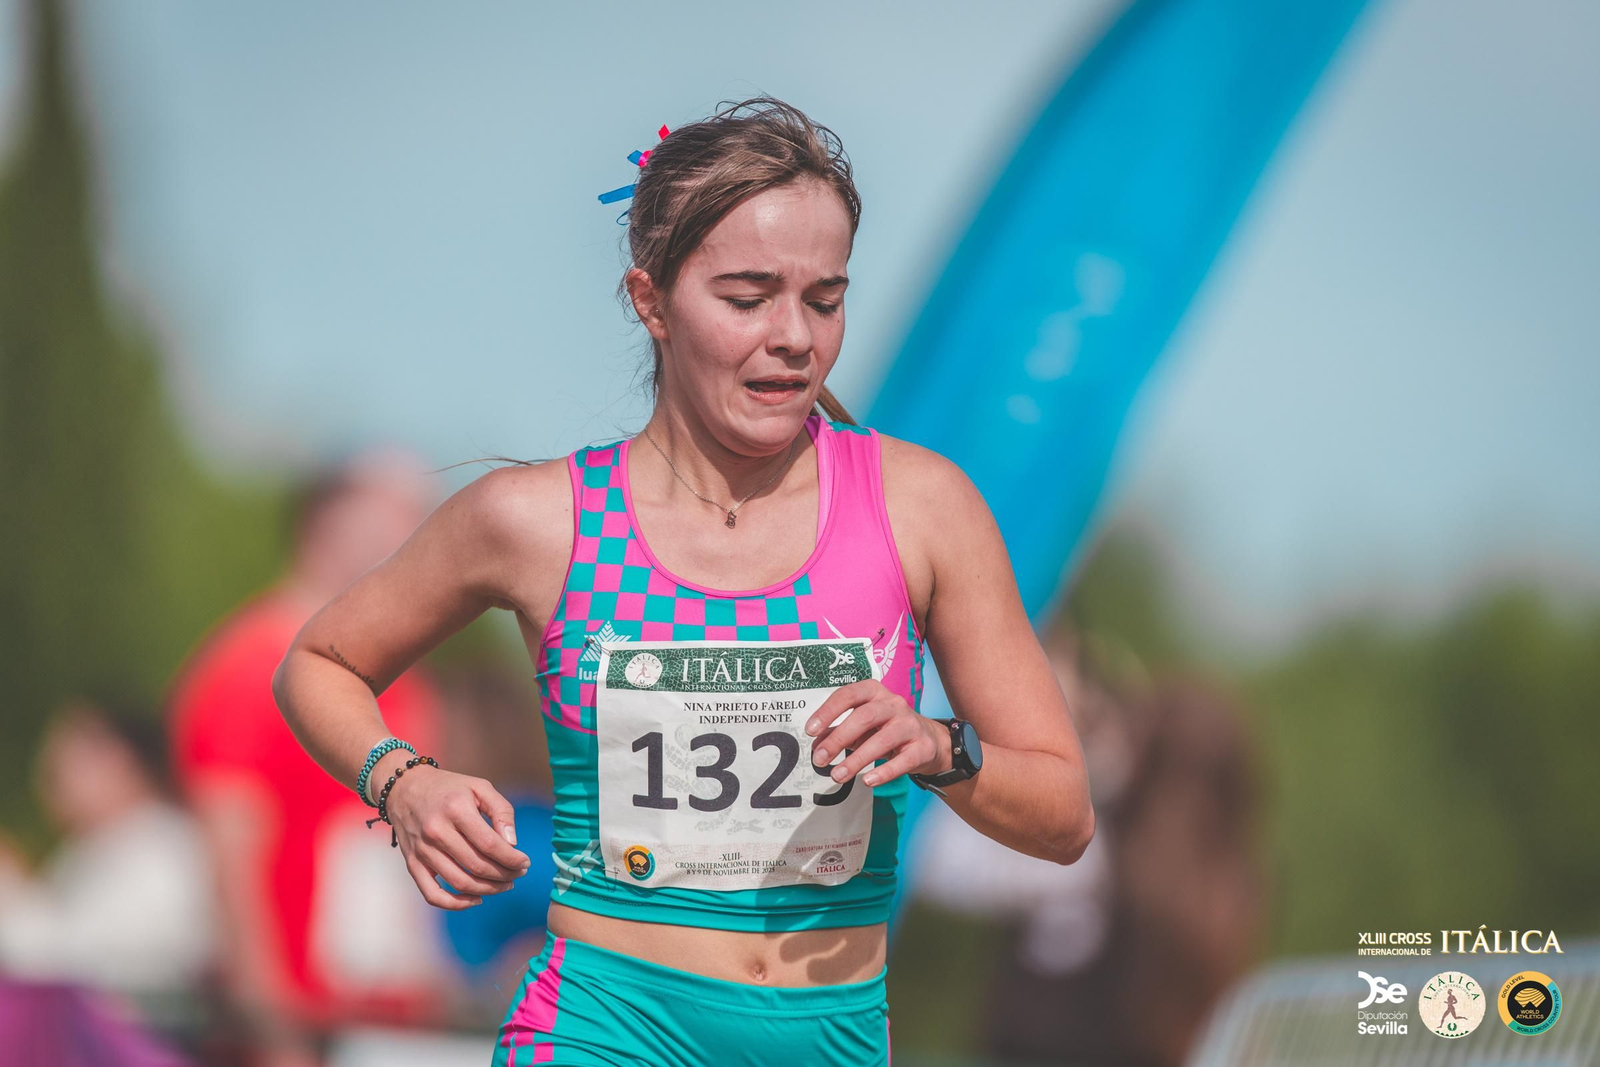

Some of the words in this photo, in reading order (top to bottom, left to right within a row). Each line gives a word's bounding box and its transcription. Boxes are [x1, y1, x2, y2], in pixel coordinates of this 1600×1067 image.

[681, 651, 809, 683] ITÁLICA
[829, 674, 857, 684] Sevilla
[774, 681, 809, 690] COUNTRY
[683, 702, 712, 711] NINA
[715, 702, 759, 711] PRIETO
[761, 699, 807, 711] FARELO
[699, 713, 792, 724] INDEPENDIENTE
[697, 861, 749, 869] INTERNACIONAL
[816, 864, 846, 874] ITÁLICA
[713, 868, 749, 876] NOVIEMBRE
